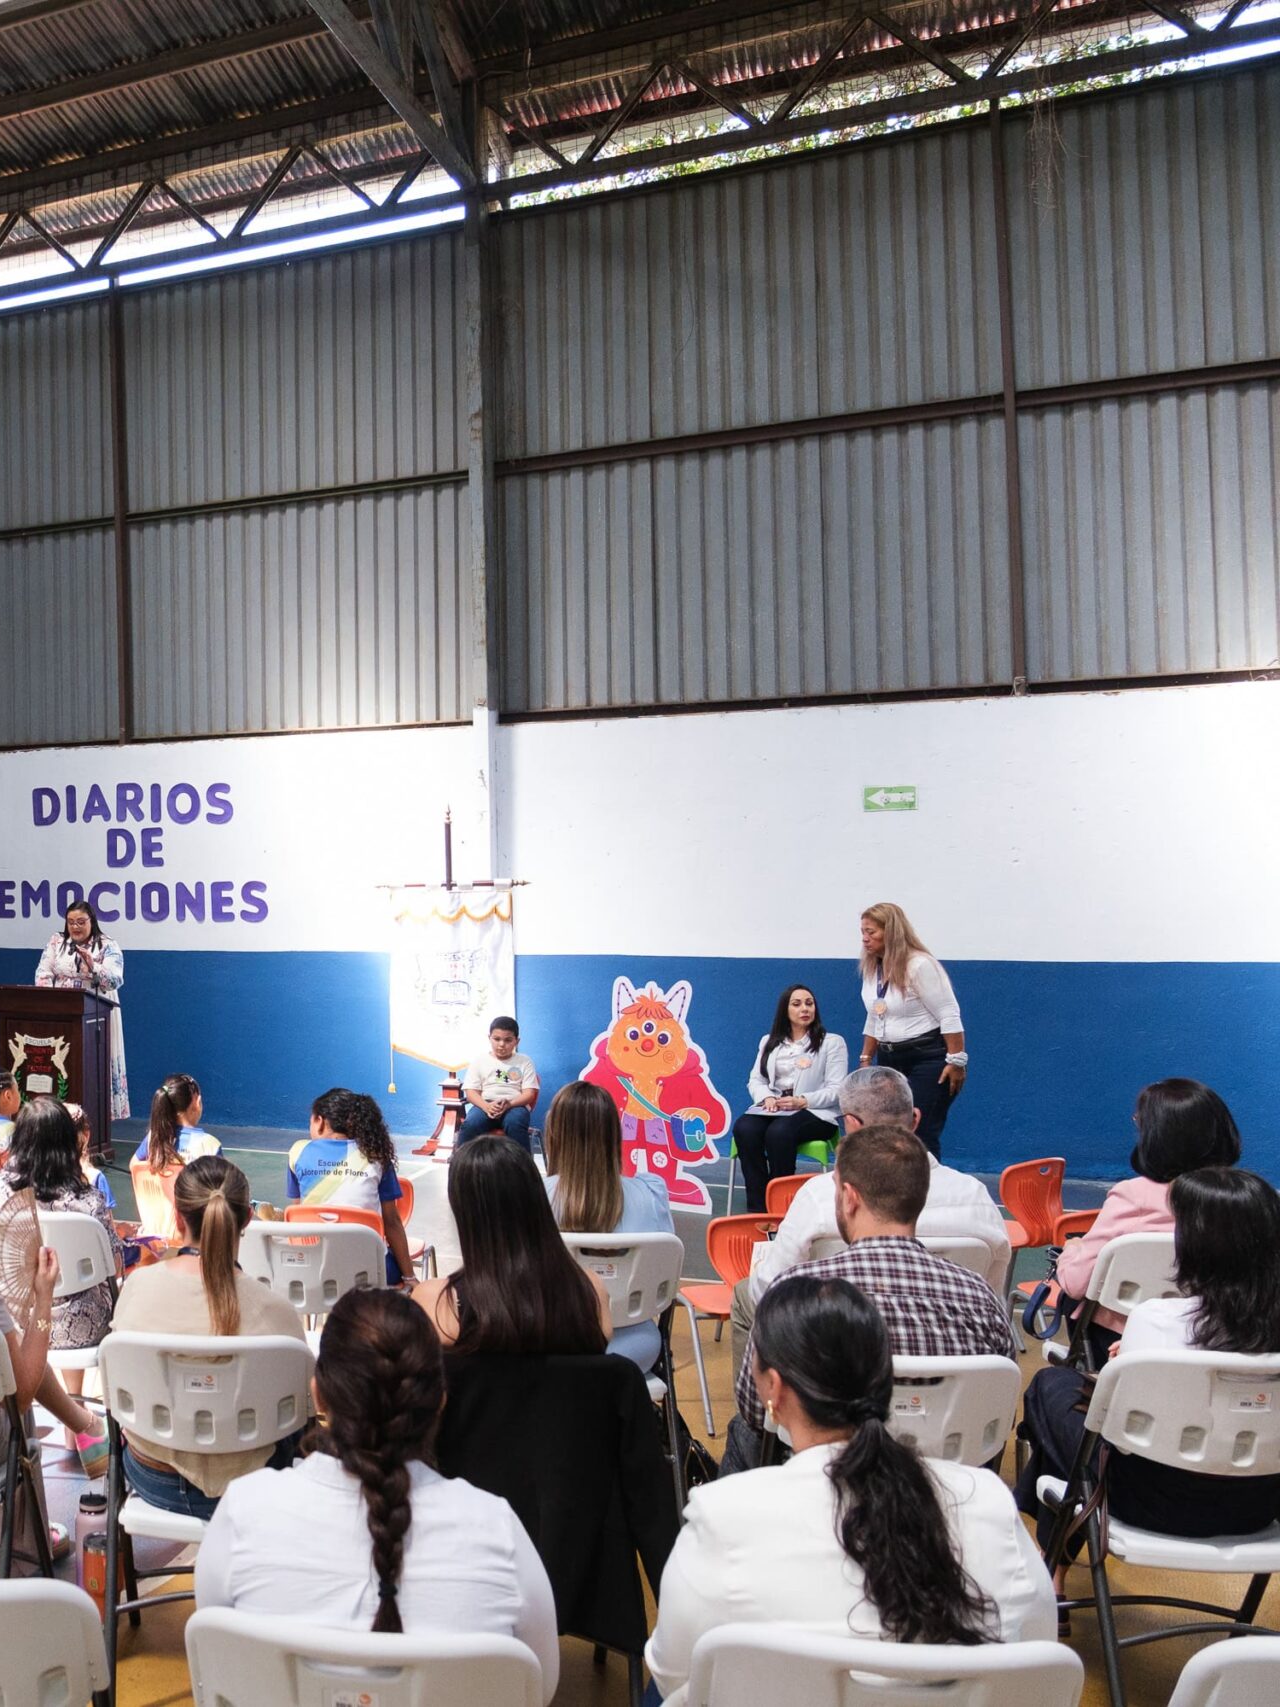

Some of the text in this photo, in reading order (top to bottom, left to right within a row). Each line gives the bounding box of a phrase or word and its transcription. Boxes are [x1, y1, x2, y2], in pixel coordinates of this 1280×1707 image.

[32, 782, 234, 827] DIARIOS
[106, 827, 165, 868] DE
[345, 1168, 368, 1177] Flores
